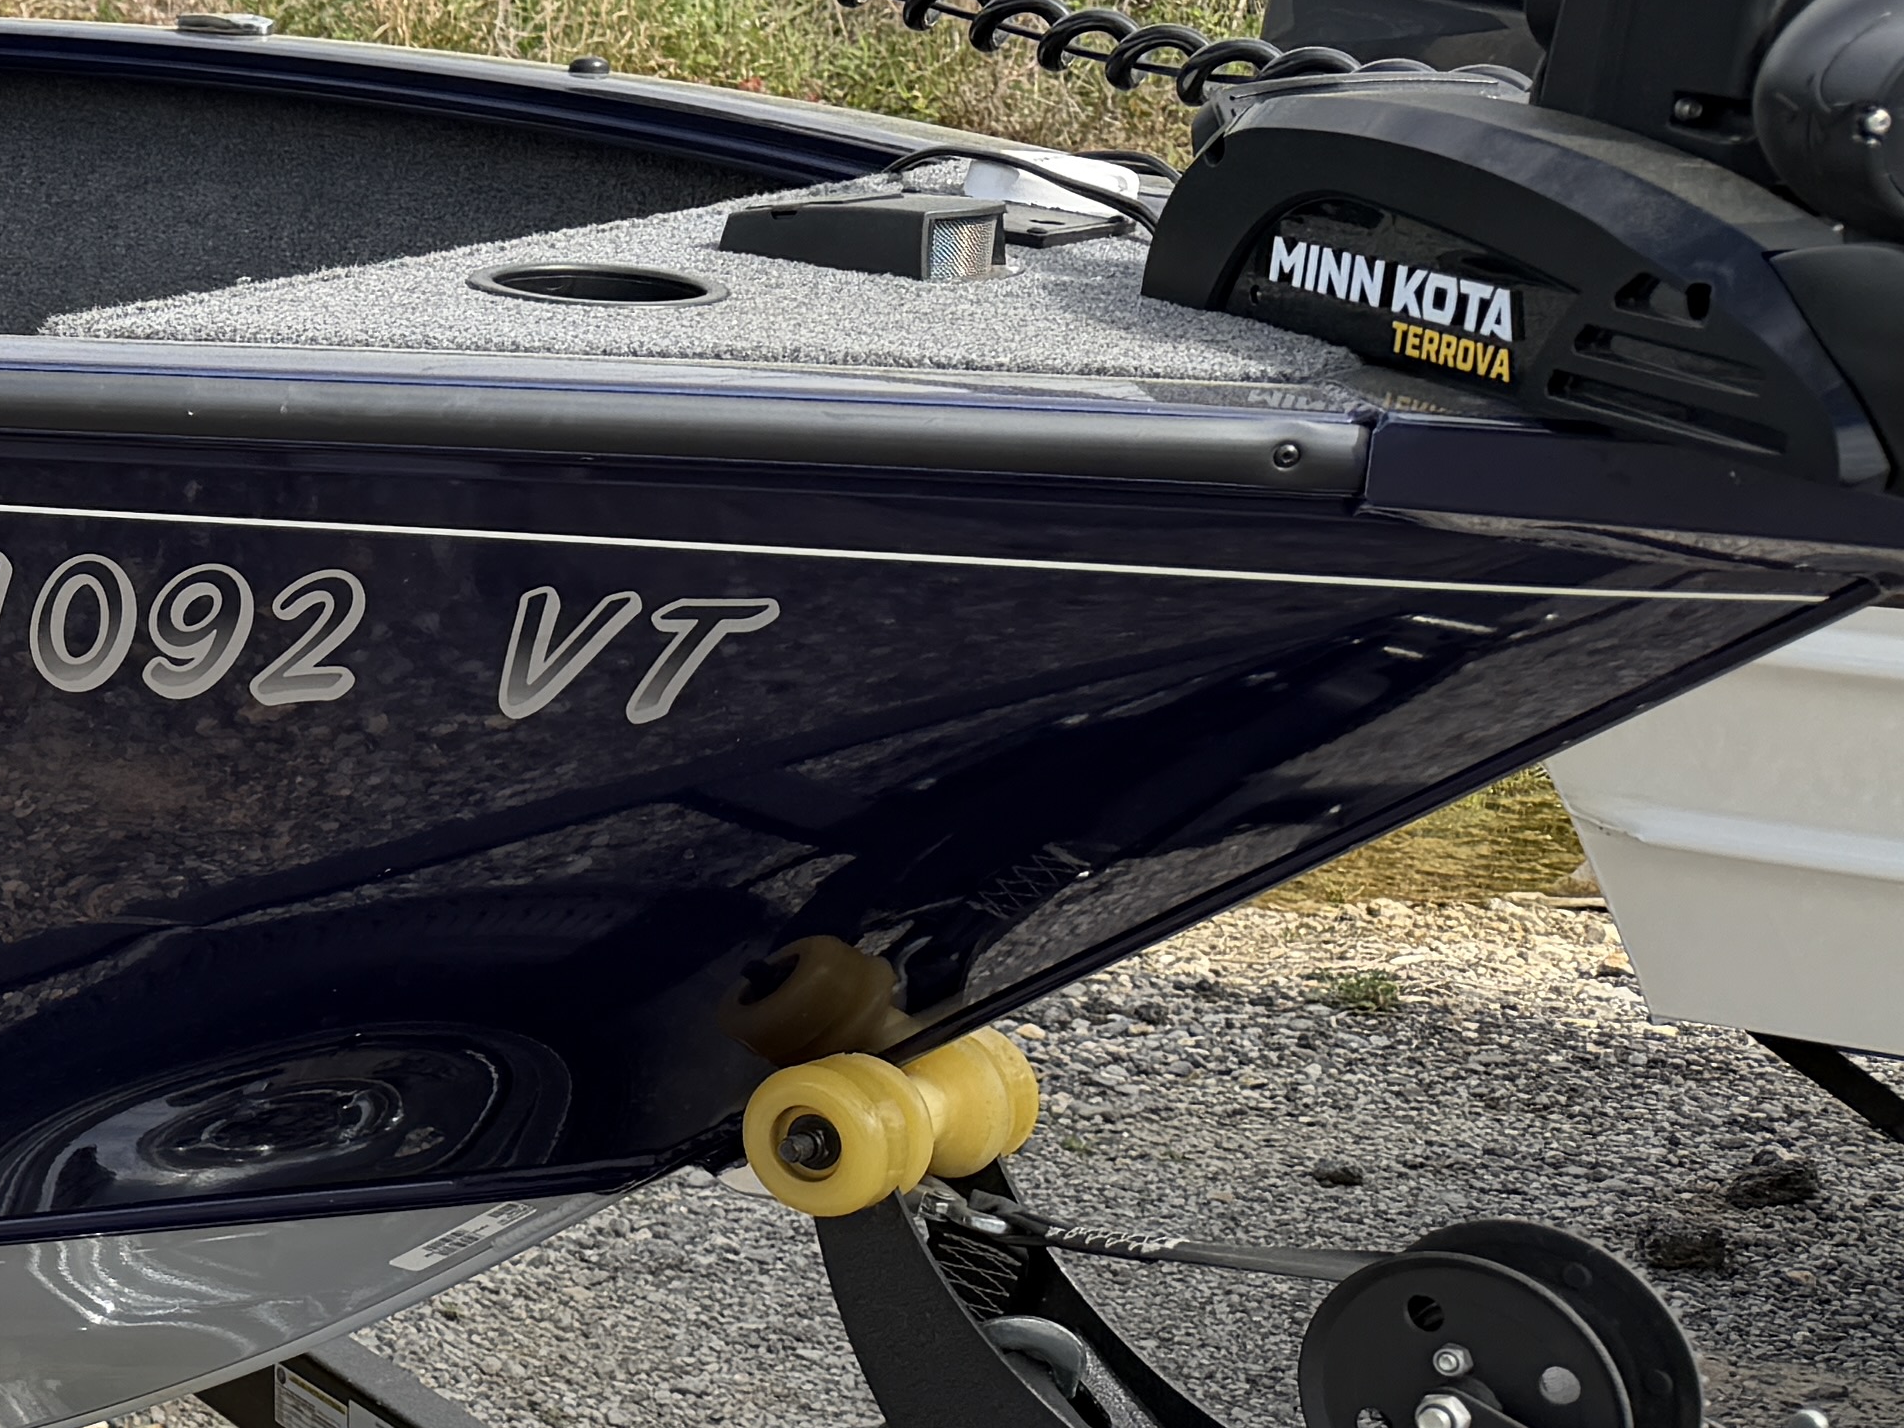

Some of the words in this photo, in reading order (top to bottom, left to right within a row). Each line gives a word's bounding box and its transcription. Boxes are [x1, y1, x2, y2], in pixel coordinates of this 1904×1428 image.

[1269, 235, 1386, 308] MINN
[1391, 264, 1513, 343] KOTA
[1392, 320, 1511, 384] TERROVA
[498, 585, 780, 725] VT
